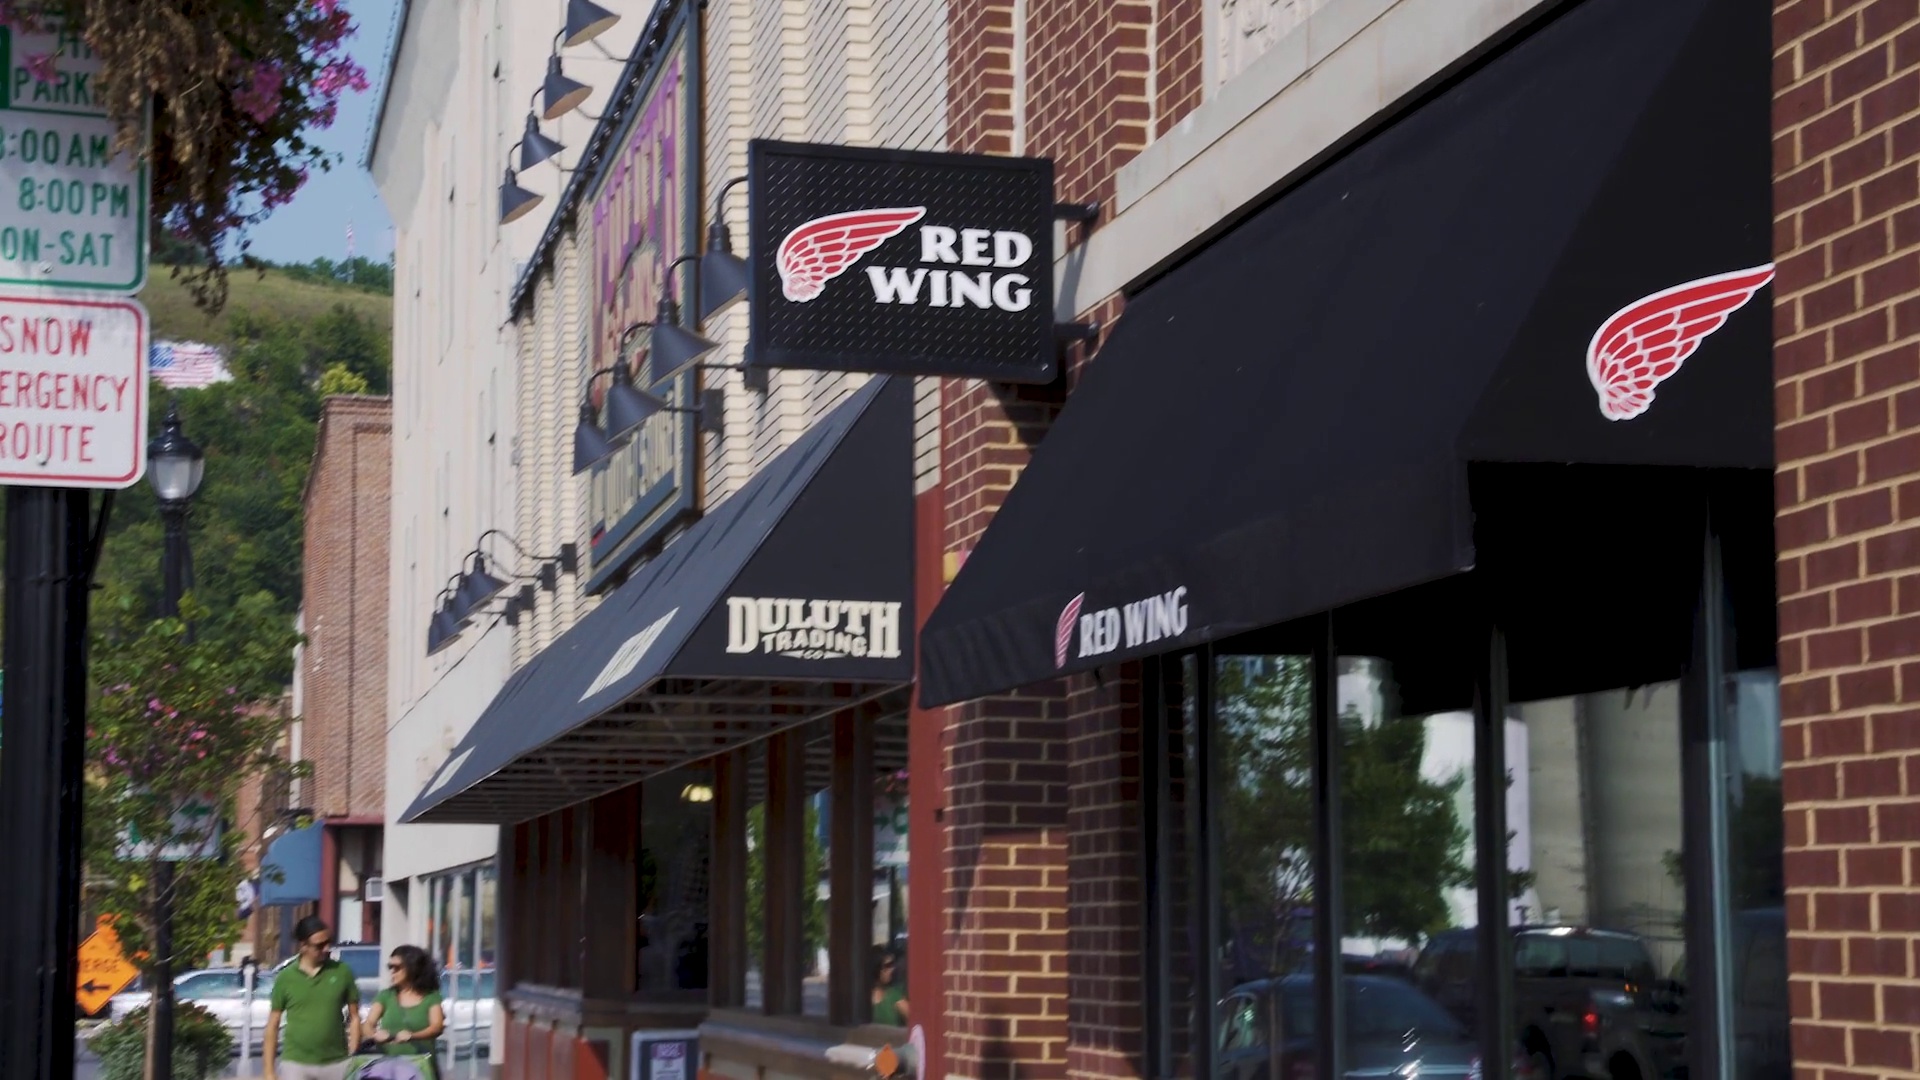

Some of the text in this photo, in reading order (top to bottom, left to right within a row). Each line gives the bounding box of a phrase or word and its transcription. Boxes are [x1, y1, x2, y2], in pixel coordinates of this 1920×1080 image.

[14, 67, 98, 106] PARK
[919, 225, 1033, 268] RED
[865, 265, 1033, 313] WING
[0, 315, 92, 357] SNOW
[726, 596, 902, 659] DULUTH
[1078, 585, 1188, 658] RED WING
[761, 629, 868, 658] TRADING
